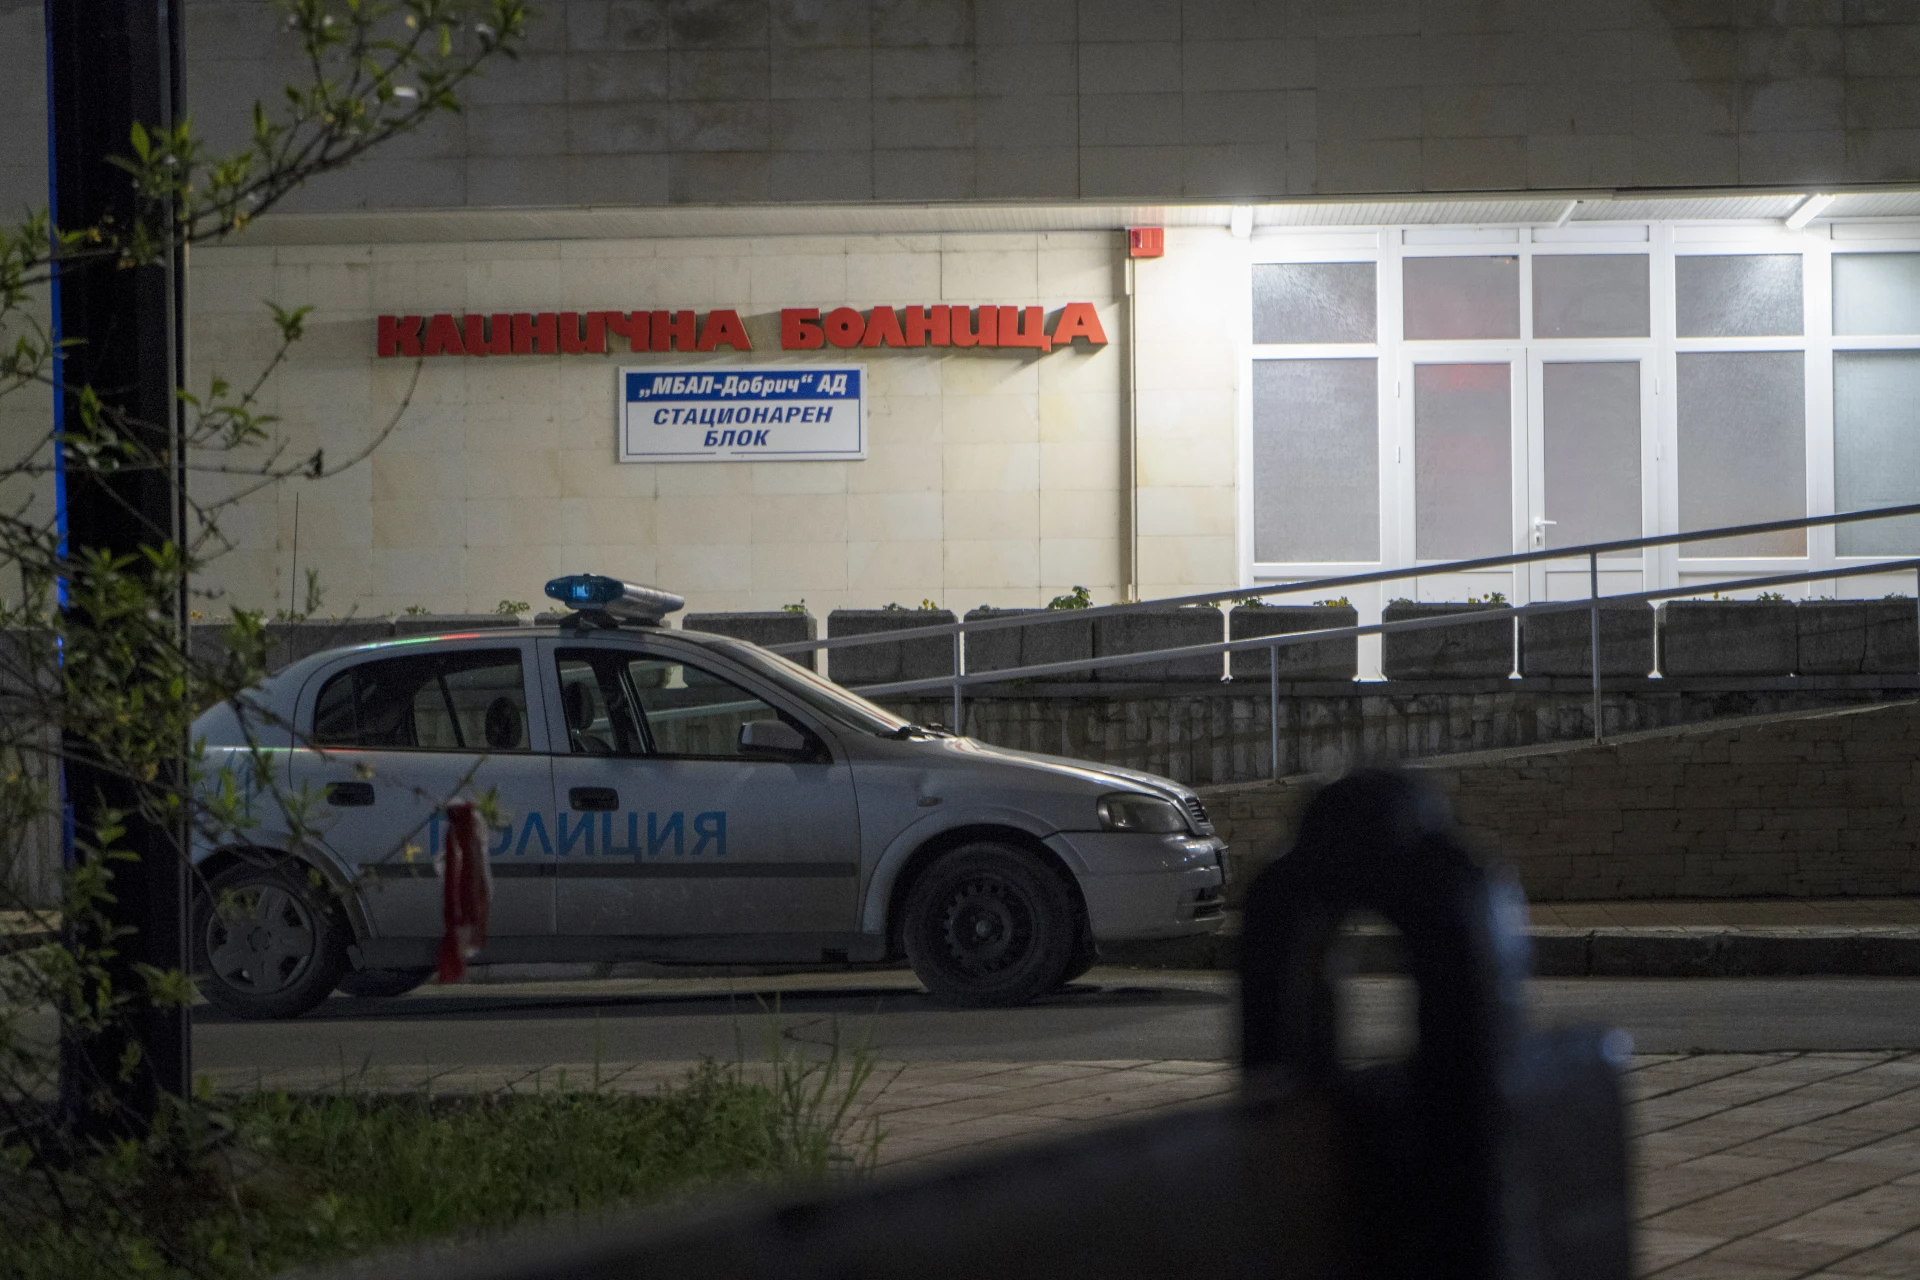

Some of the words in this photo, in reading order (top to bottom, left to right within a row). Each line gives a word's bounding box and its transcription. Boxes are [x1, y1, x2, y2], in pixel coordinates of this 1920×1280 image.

[378, 310, 752, 357] КЛИНИЧНА
[781, 302, 1109, 352] БОЛНИЦА
[816, 374, 848, 395] АД
[653, 406, 833, 428] СТАЦИОНАРЕН
[703, 429, 771, 447] БЛОК
